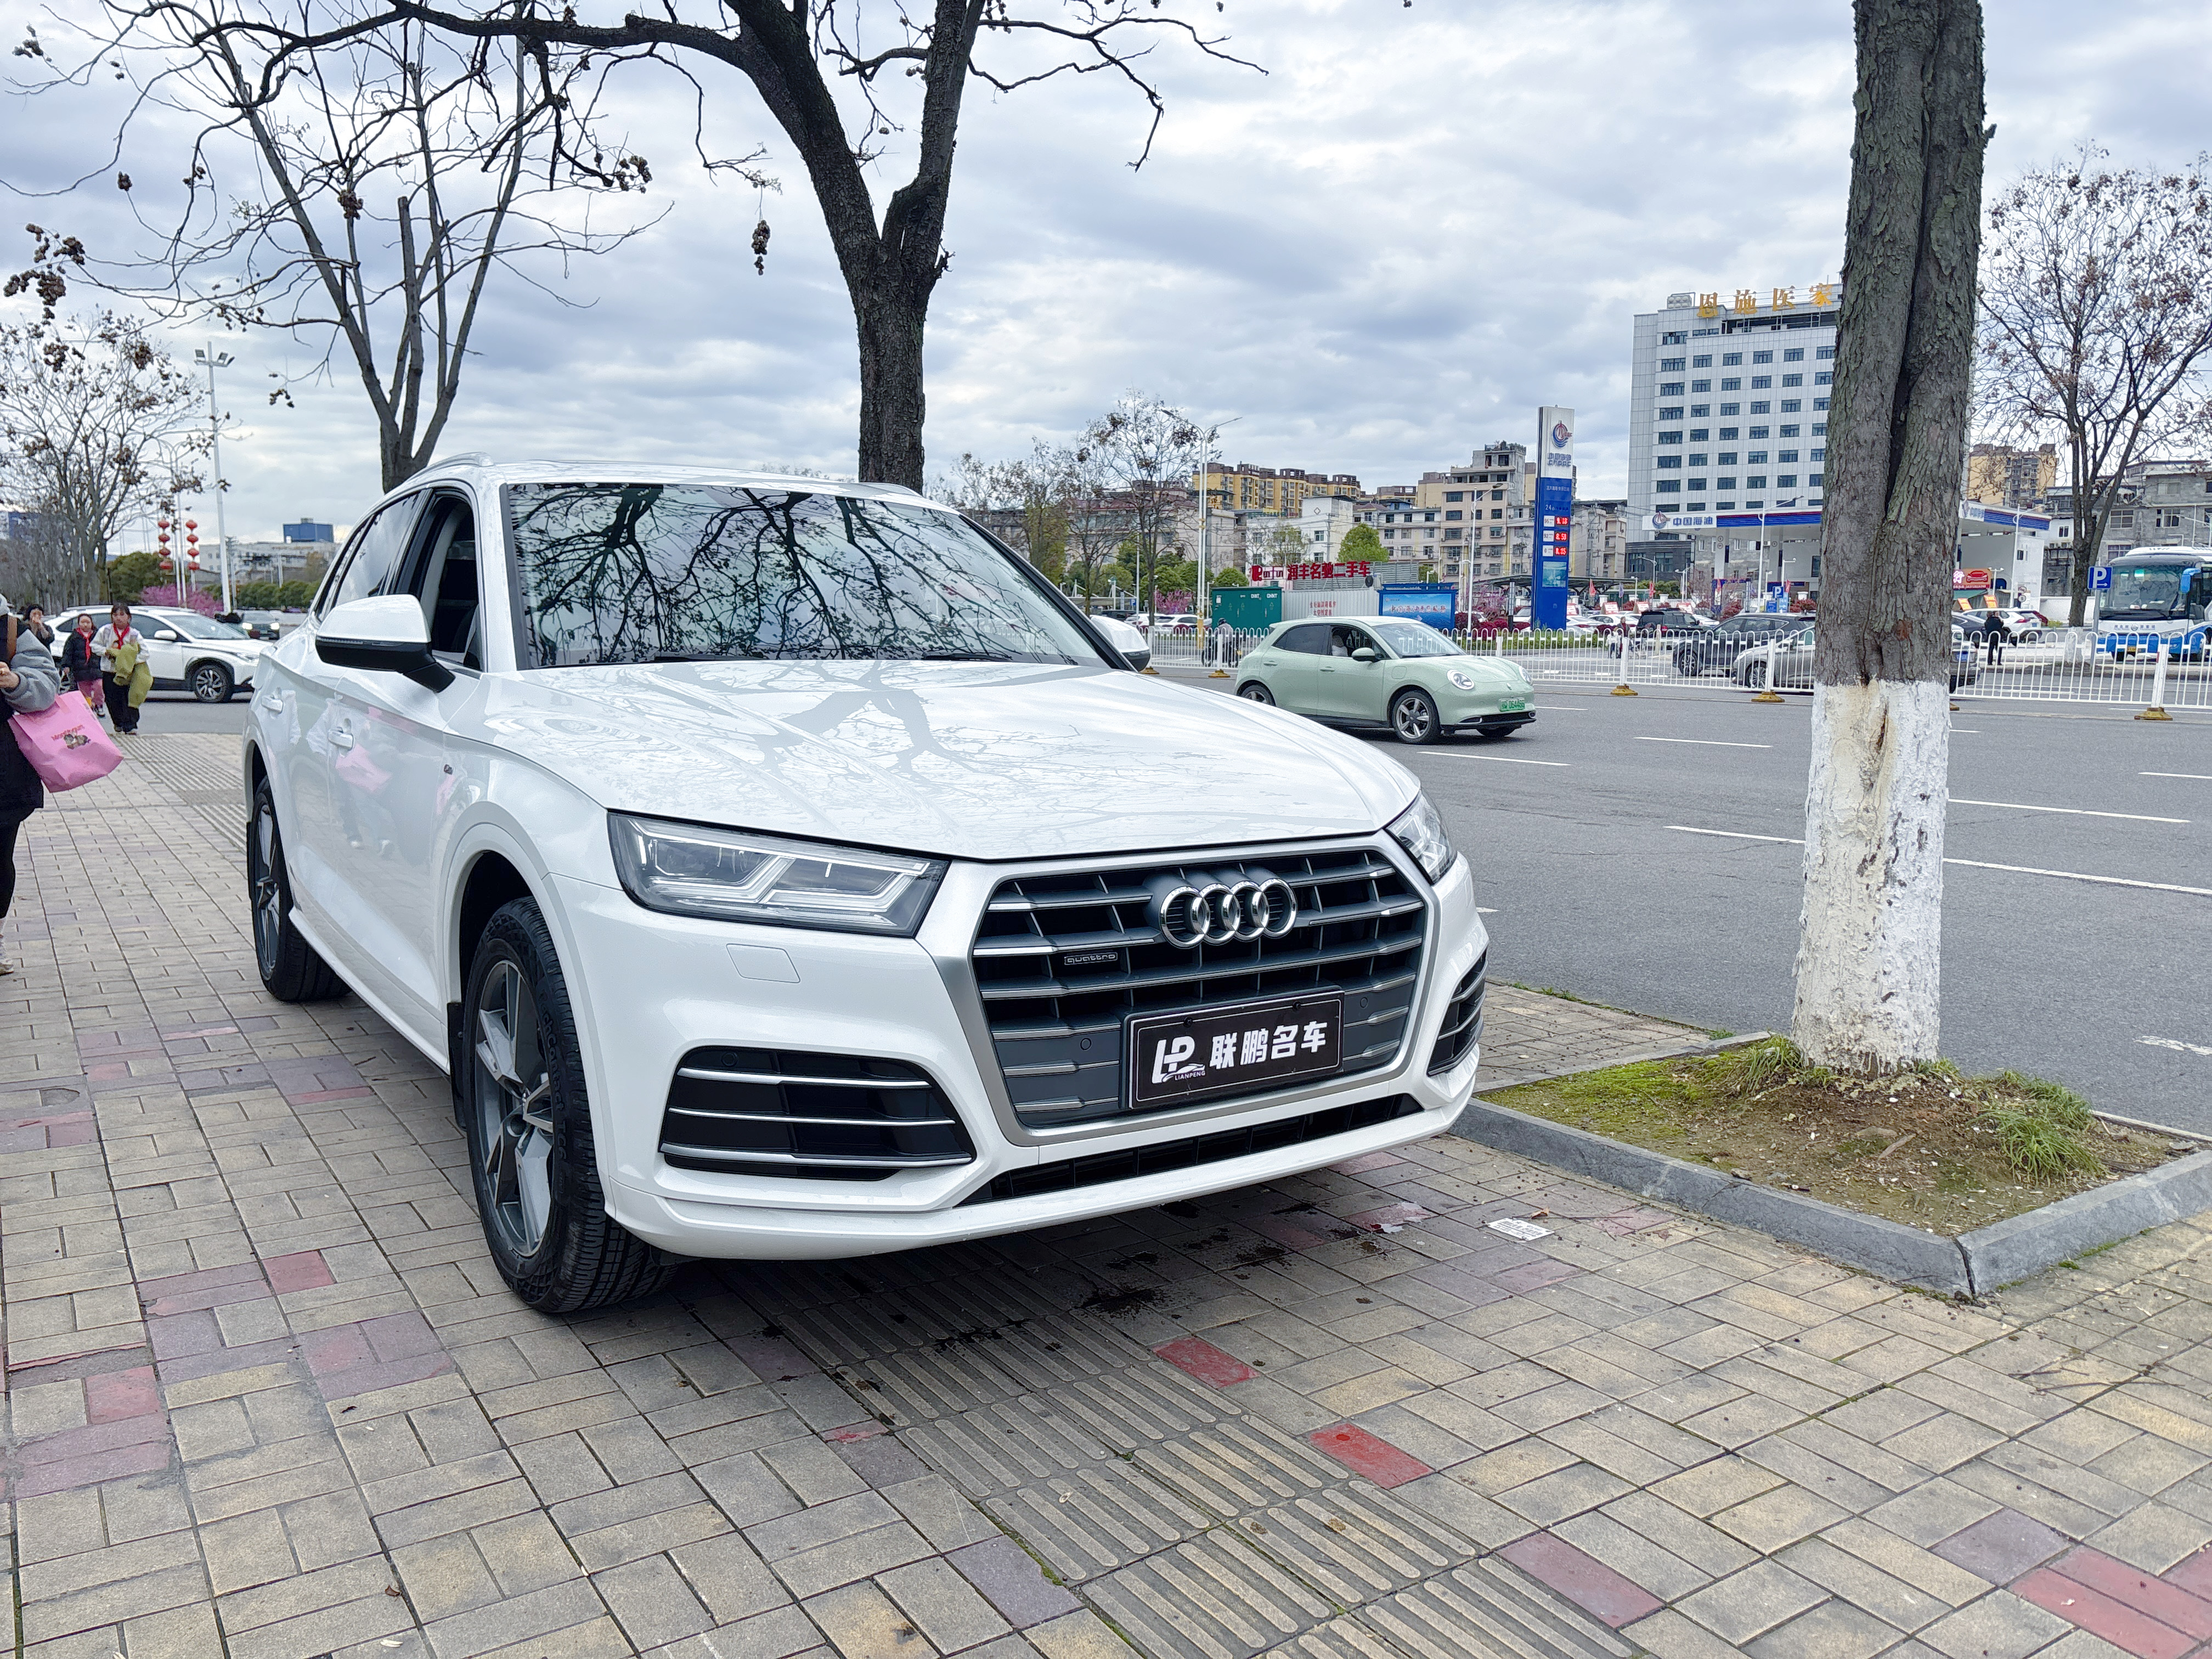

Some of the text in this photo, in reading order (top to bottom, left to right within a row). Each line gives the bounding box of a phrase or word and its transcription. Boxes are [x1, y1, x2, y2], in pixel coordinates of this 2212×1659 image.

[1673, 516, 1713, 526] 中国海油
[1288, 560, 1370, 580] 润丰名驰二手车
[2092, 568, 2107, 589] P
[1775, 586, 1782, 599] P
[1067, 954, 1115, 964] quattro
[1209, 1021, 1328, 1069] 联鹏名车
[1175, 1070, 1206, 1081] LIANPENG
